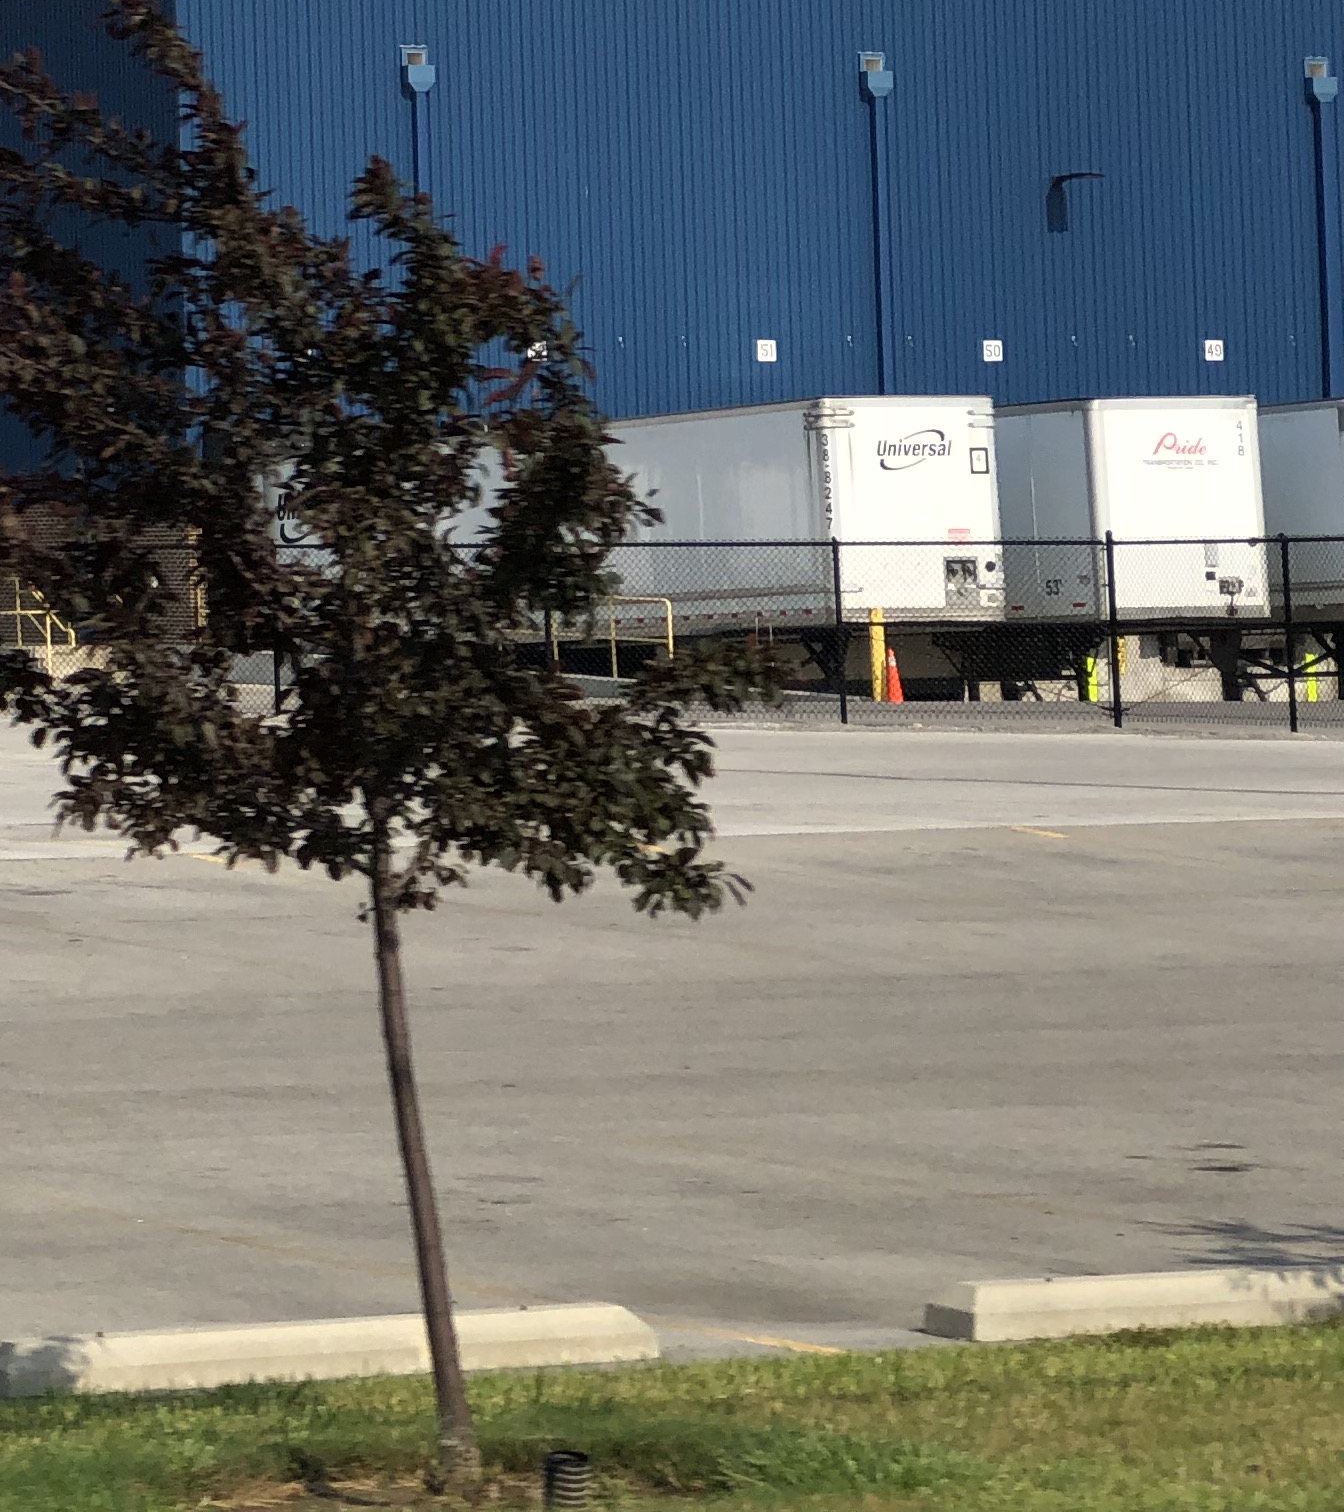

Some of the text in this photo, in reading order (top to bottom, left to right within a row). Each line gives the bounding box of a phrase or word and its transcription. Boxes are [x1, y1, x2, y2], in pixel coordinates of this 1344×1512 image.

[760, 343, 773, 358] 51
[985, 344, 1001, 358] 50
[1207, 343, 1223, 357] 49
[876, 438, 953, 457] Universal
[1152, 432, 1208, 456] Pride
